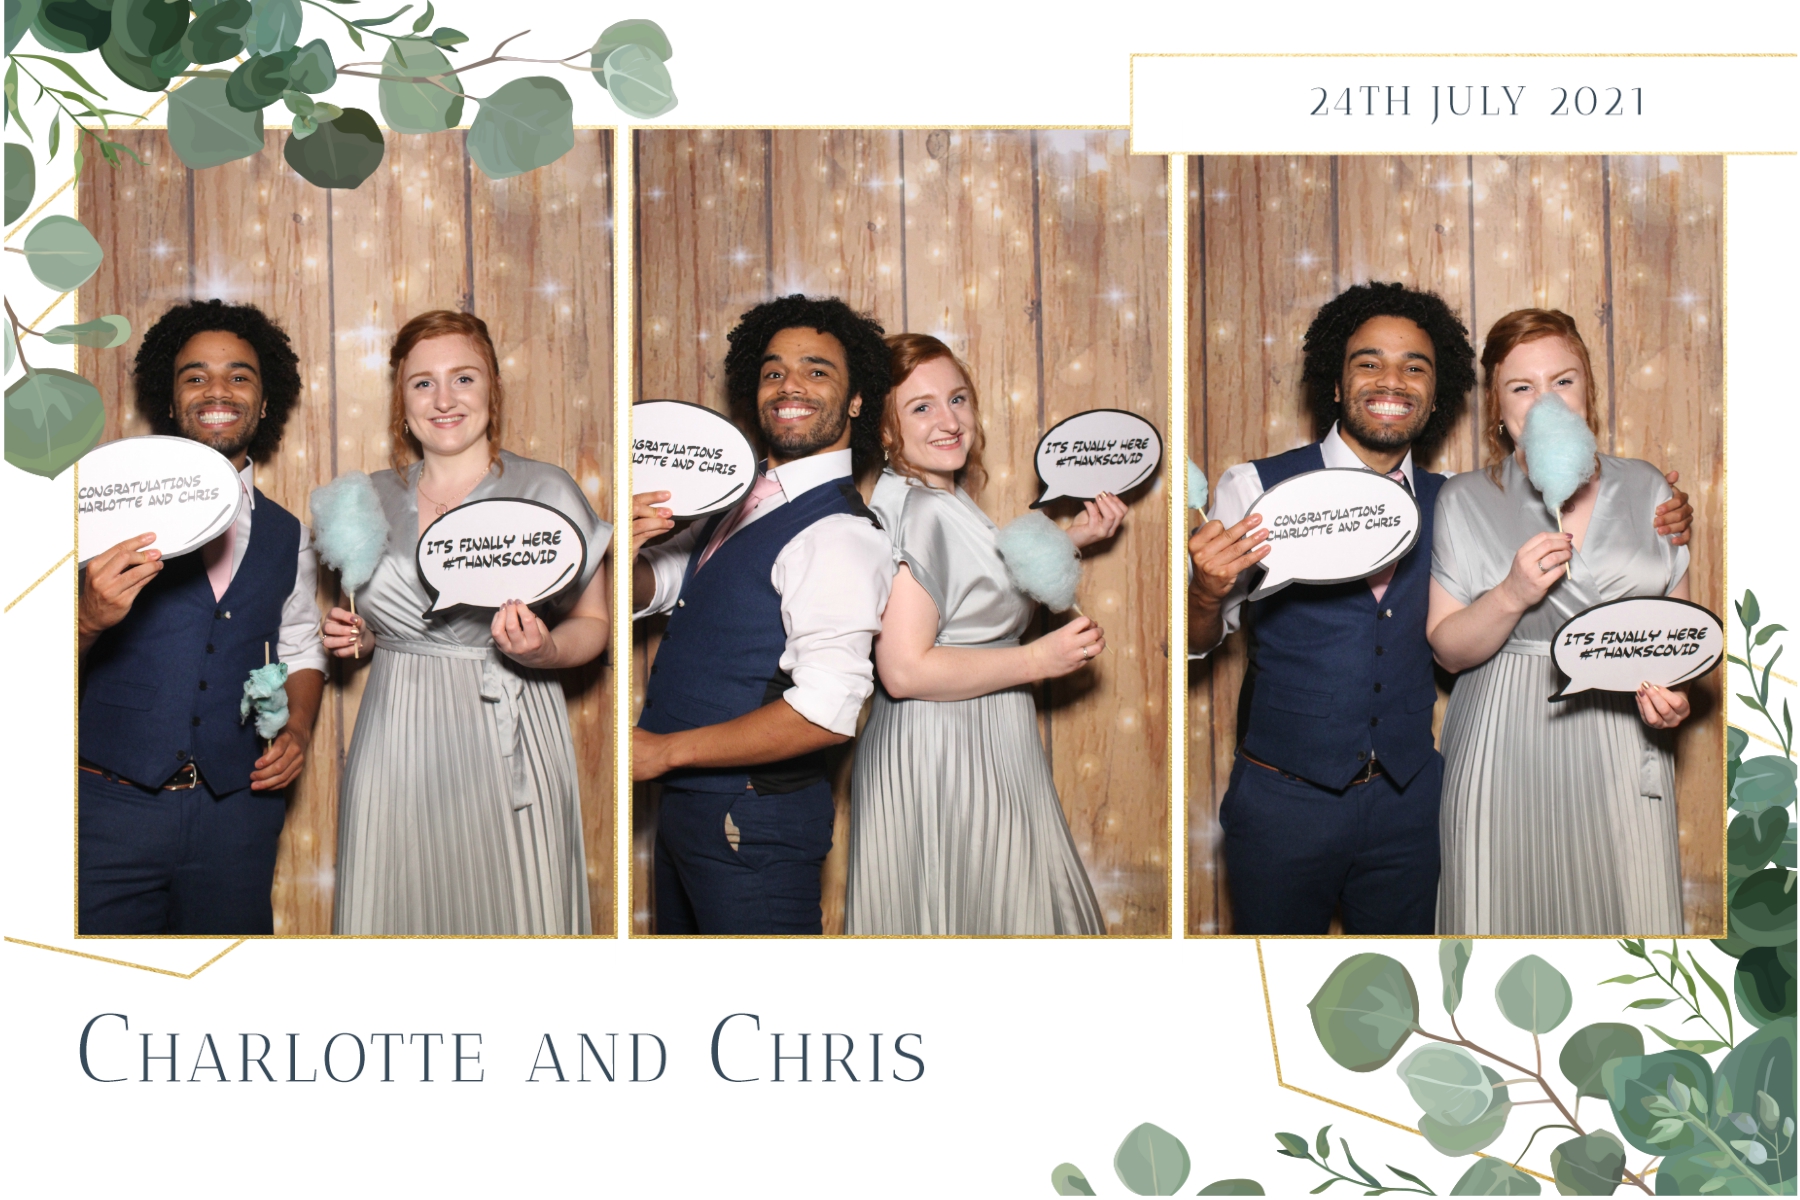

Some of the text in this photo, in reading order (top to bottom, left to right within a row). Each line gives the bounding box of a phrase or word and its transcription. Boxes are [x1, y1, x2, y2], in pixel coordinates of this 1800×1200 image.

[1045, 438, 1149, 454] ITS FINALLY HERE
[632, 453, 737, 475] LOTTE AND CHRIS
[1056, 452, 1143, 468] #THANKSCOVID
[78, 474, 201, 499] CONGRATULATIONS
[78, 488, 219, 514] HARLOTTE AND CHRIS
[1274, 504, 1385, 527] CONGRATULATIONS
[1266, 515, 1401, 541] CHARLOTTE AND CHRIS
[426, 530, 562, 555] ITS FINALLY HERE
[442, 549, 557, 571] #THANKSCOVID
[1564, 627, 1708, 646] ITS FINALLY HERE
[1579, 643, 1700, 660] #THANKSCOVID
